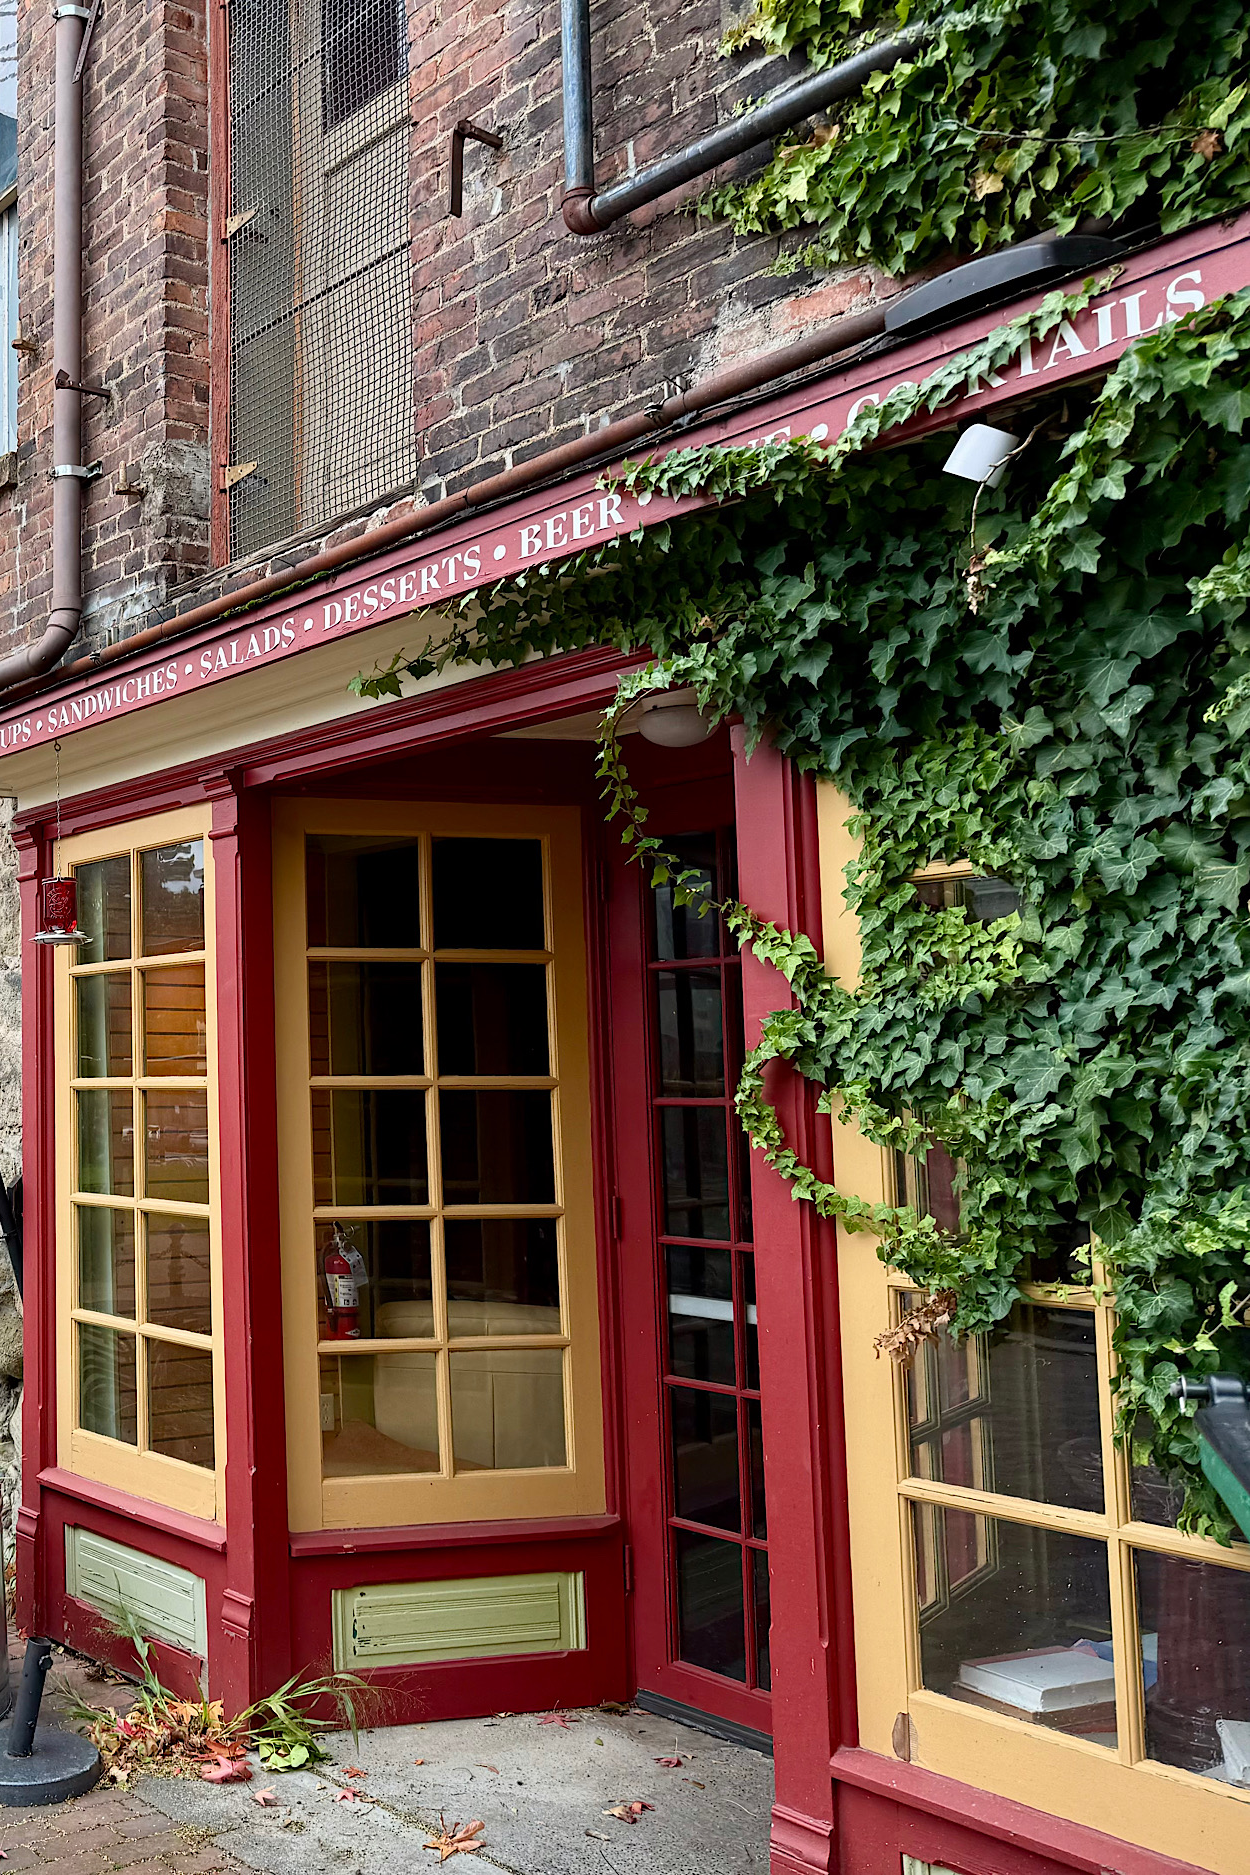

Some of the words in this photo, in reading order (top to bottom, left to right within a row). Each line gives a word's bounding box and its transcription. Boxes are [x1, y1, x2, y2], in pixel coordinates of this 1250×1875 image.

[47, 662, 178, 733] SANDWICHES
[199, 617, 296, 679] SALADS
[322, 545, 482, 631] DESSERTS
[517, 493, 626, 560] BEER
